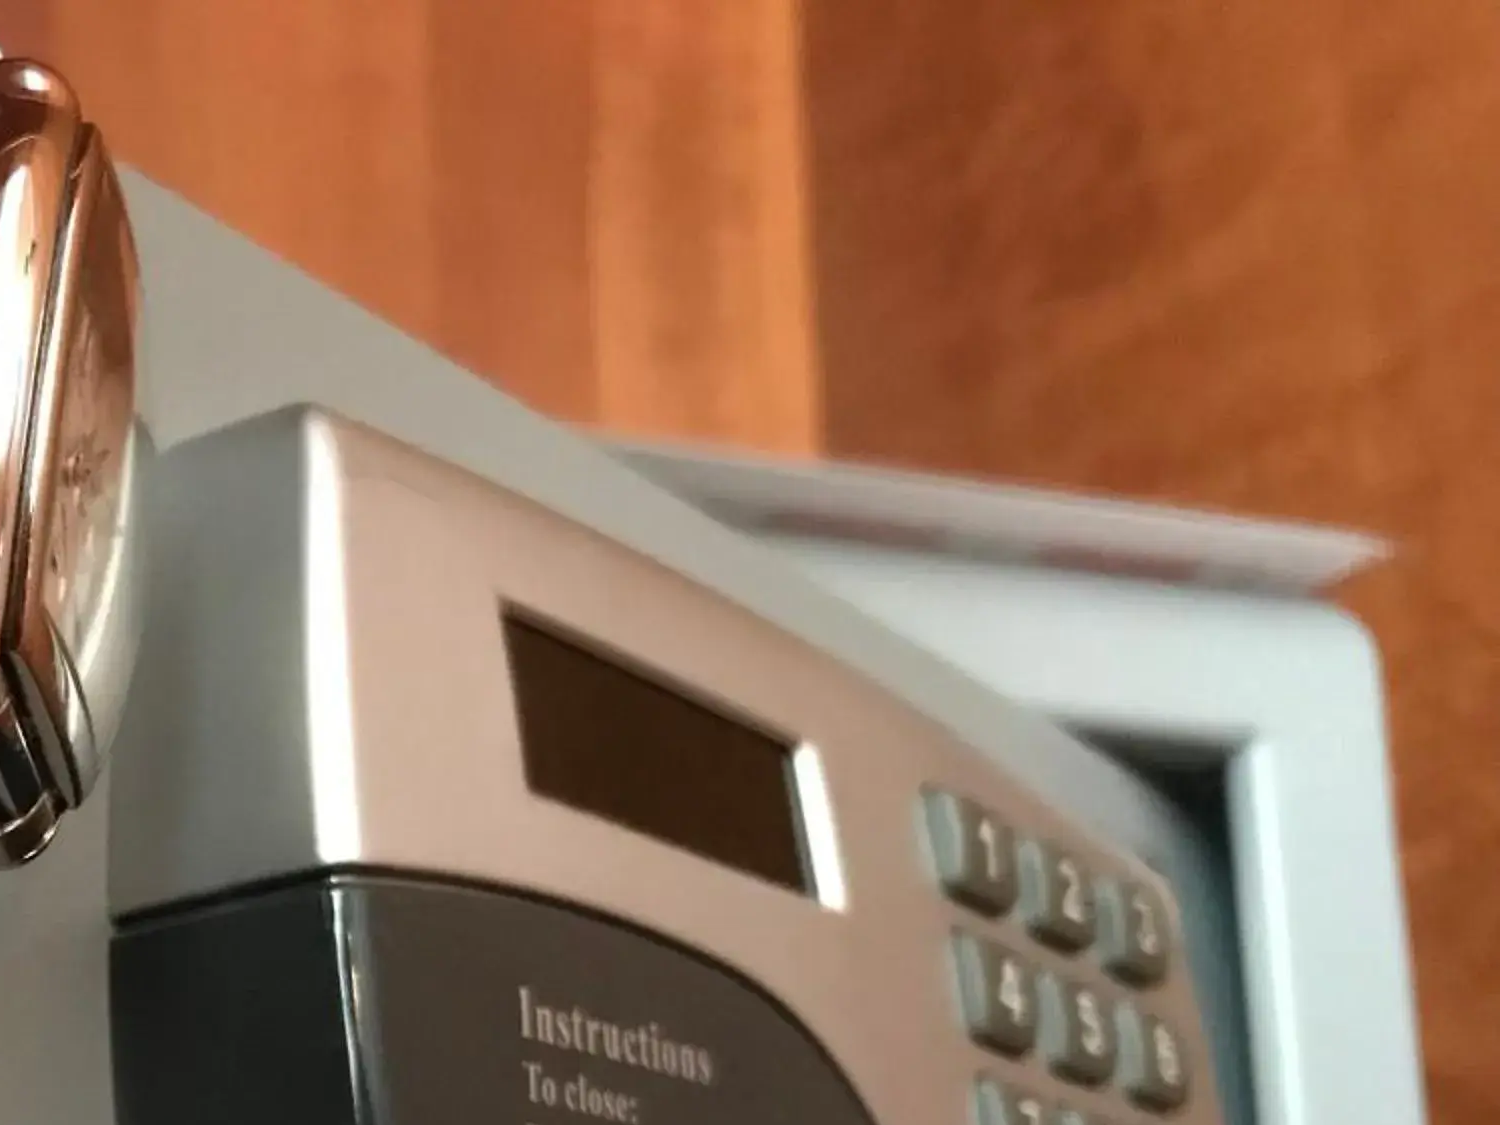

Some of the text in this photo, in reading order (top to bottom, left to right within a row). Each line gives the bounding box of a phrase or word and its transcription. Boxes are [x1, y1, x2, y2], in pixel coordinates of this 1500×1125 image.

[979, 816, 998, 880] 1
[1057, 858, 1085, 924] 2
[519, 985, 713, 1086] Instructions
[999, 957, 1181, 1086] 4 5 6
[522, 1061, 639, 1125] To close:
